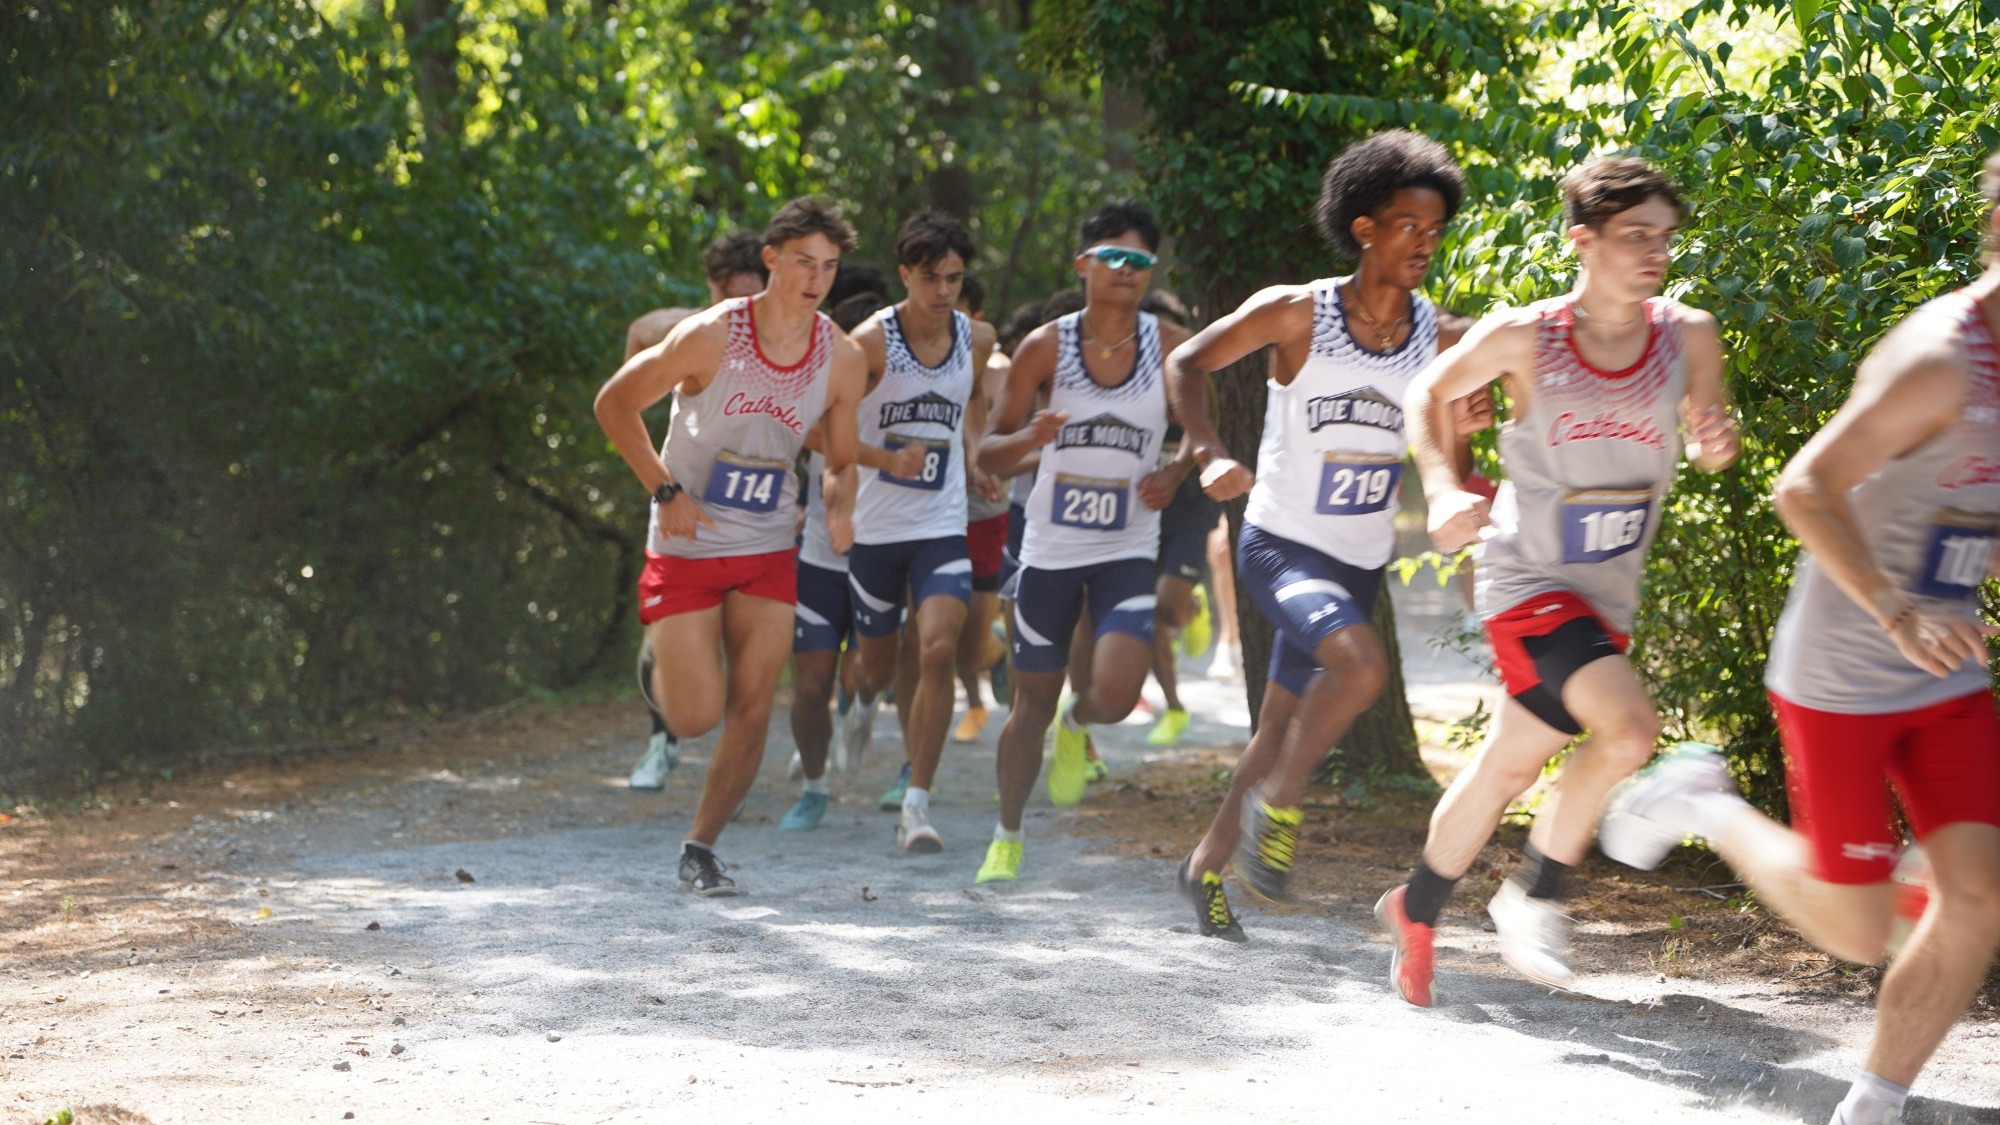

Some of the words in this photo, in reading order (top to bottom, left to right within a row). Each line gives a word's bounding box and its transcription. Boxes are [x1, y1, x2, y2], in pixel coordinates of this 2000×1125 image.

[724, 392, 803, 435] Catholic
[880, 402, 914, 427] THE
[1307, 397, 1351, 431] THE
[1548, 411, 1667, 450] Catholic
[724, 470, 775, 504] 114
[1328, 468, 1391, 506] 219
[1062, 488, 1118, 525] 230
